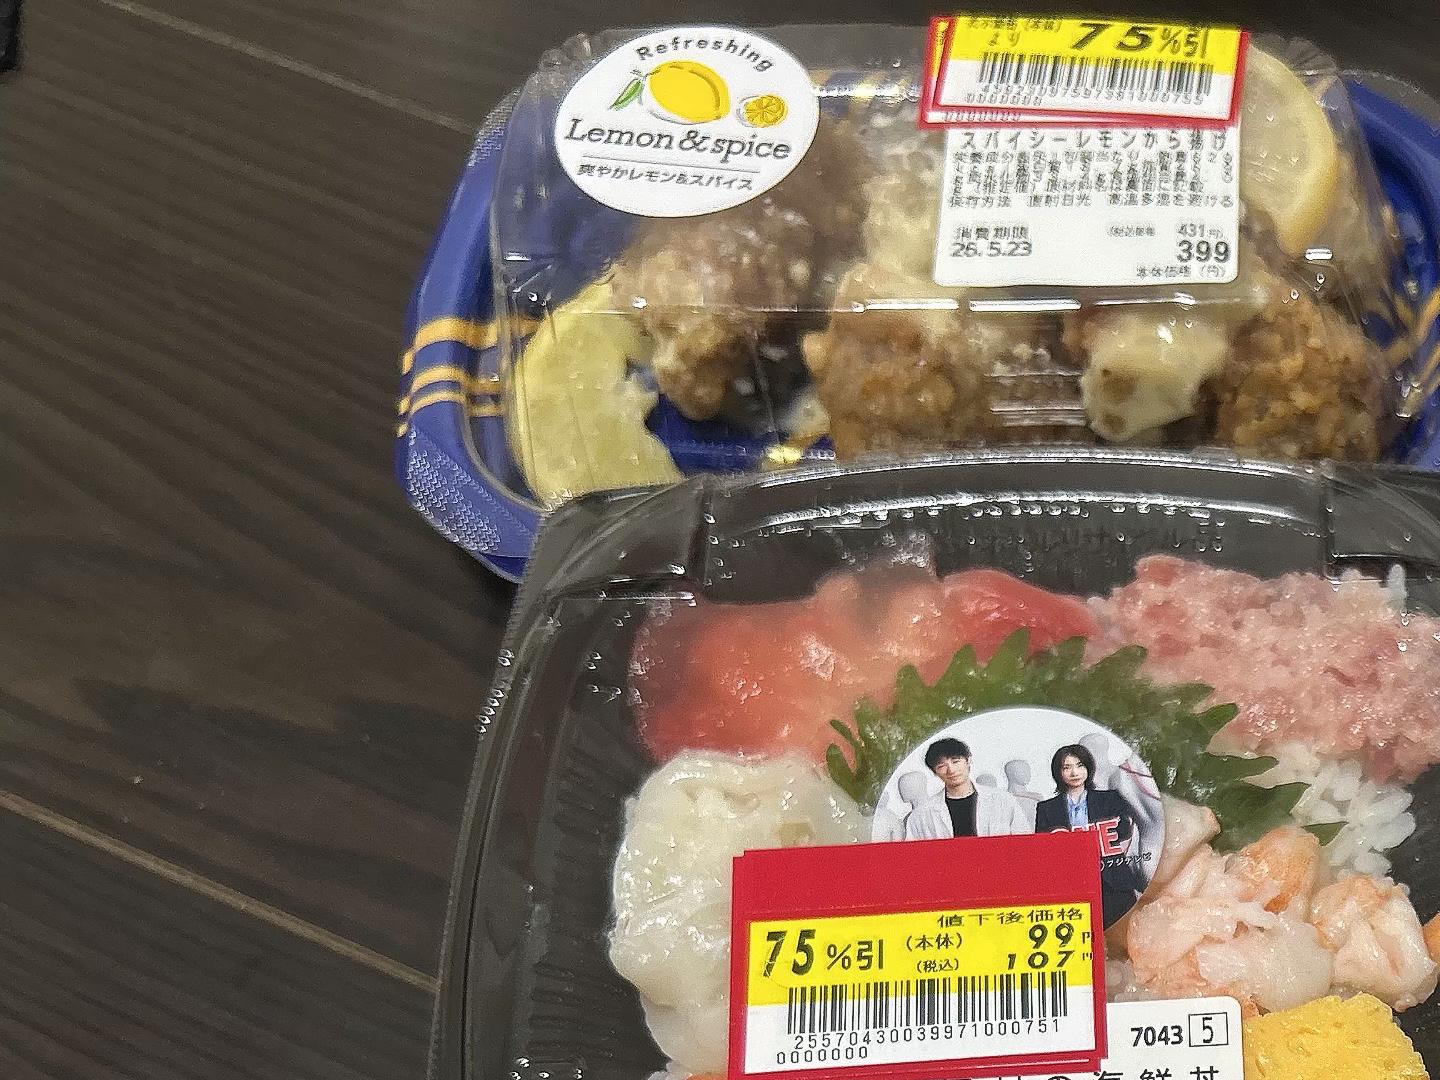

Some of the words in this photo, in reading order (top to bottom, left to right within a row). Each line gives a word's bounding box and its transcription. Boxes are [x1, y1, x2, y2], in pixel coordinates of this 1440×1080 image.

[1070, 22, 1210, 59] 75%引
[636, 36, 774, 73] Refreshing
[1177, 240, 1230, 264] 399
[936, 906, 1084, 929] 値下後価格
[763, 928, 884, 979] 75%引
[904, 931, 963, 952] (本体)
[916, 958, 960, 973] (税込)
[795, 1018, 1060, 1051] 25570430039971000751
[1130, 1025, 1184, 1047] 7043
[1201, 1016, 1215, 1045] 5
[776, 1045, 868, 1065] 0000000
